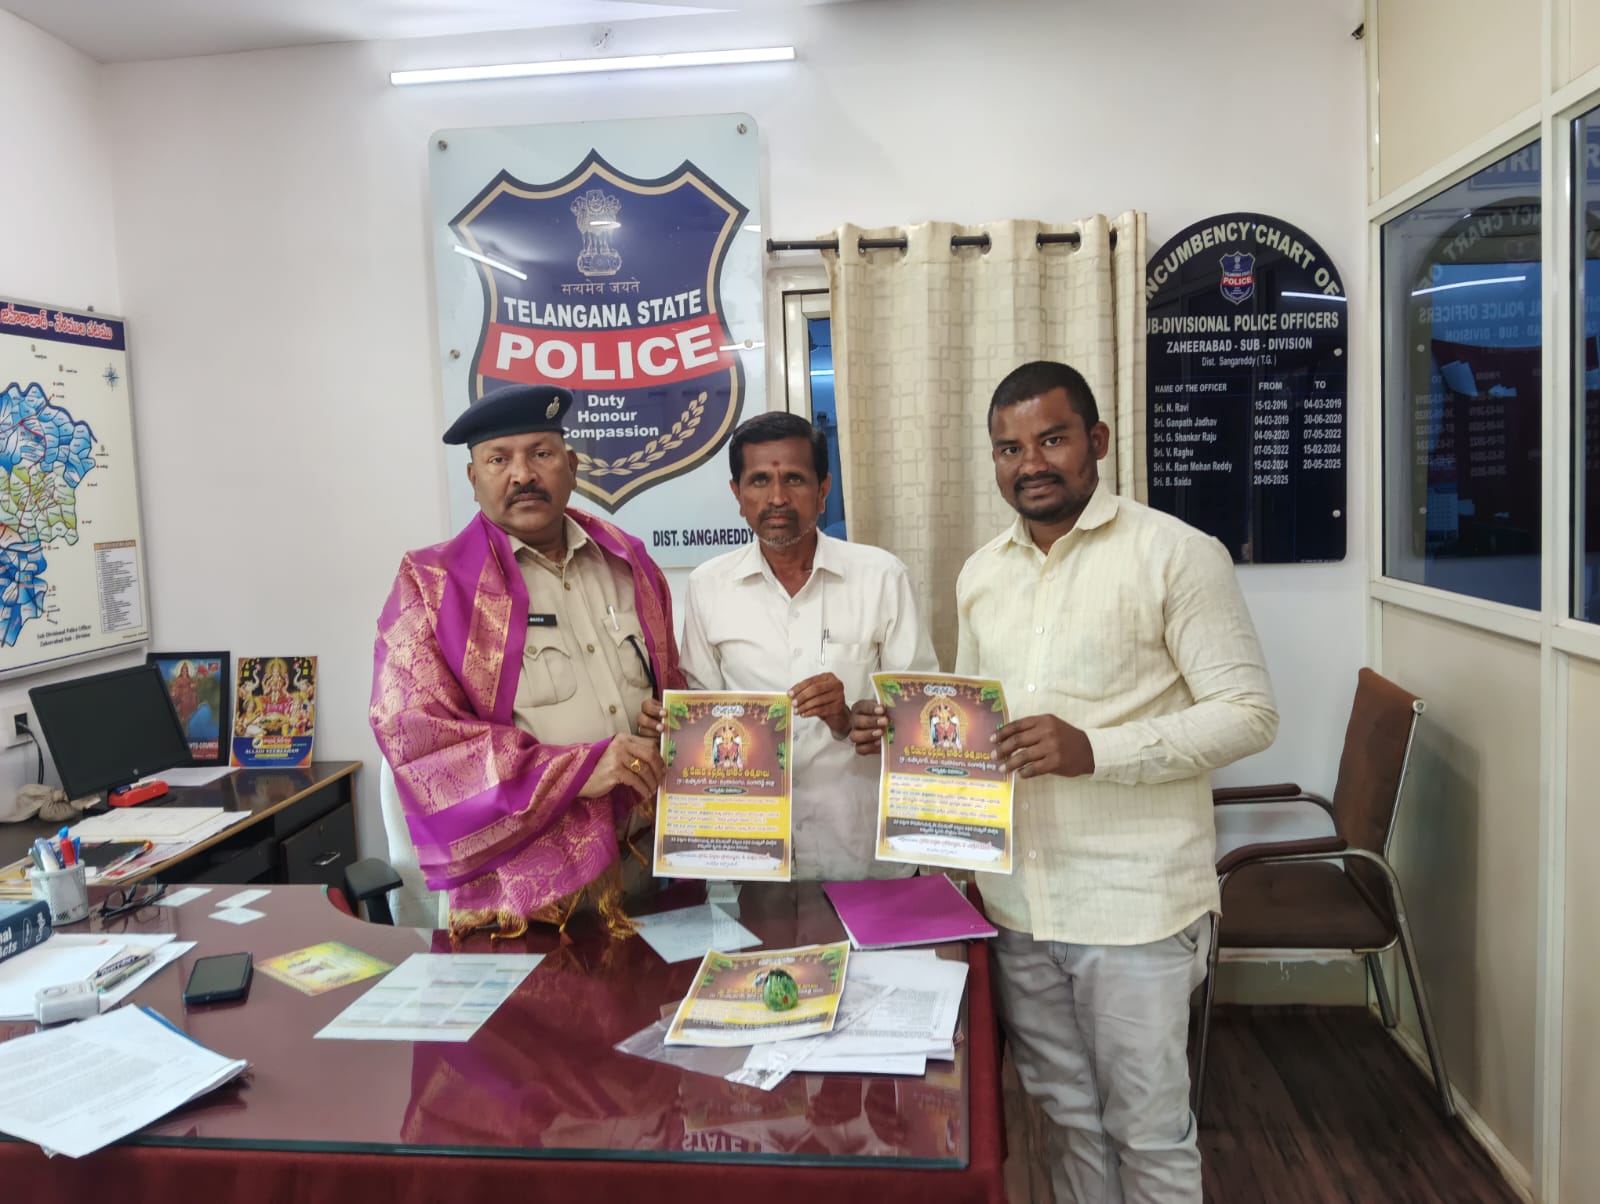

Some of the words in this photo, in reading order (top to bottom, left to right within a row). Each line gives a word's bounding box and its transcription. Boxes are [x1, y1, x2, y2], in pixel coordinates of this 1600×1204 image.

[1146, 222, 1250, 301] NCUMBENCY
[1255, 224, 1316, 269] CHART
[1314, 267, 1340, 296] OF
[561, 281, 604, 296] सत्यमेव
[608, 277, 641, 295] जयते
[1223, 277, 1253, 286] POLICE
[503, 296, 631, 329] TELANGANA
[636, 289, 702, 325] STATE
[1234, 314, 1276, 332] POLICE
[1280, 312, 1339, 330] OFFICERS
[495, 325, 720, 381] POLICE
[1166, 339, 1232, 354] ZAHEERABAD
[1240, 338, 1260, 352] SUB
[1268, 337, 1313, 351] DIVISION
[1202, 356, 1217, 367] Dist.
[1219, 355, 1257, 368] Sangareddy
[1154, 384, 1174, 393] NAME
[1175, 384, 1184, 392] OF
[1185, 384, 1199, 392] THE
[1199, 383, 1227, 392] OFFICER
[1258, 382, 1283, 391] FROM
[1315, 380, 1326, 389] TO
[587, 394, 626, 410] Duty
[577, 410, 638, 424] Honour
[562, 425, 659, 441] Compassion
[1173, 447, 1194, 459] Raghu
[1174, 462, 1189, 471] Ram
[1190, 461, 1211, 471] Mohan
[1212, 461, 1233, 473] Reddy
[653, 530, 680, 546] DIST.
[683, 528, 755, 547] SANGAREDDY
